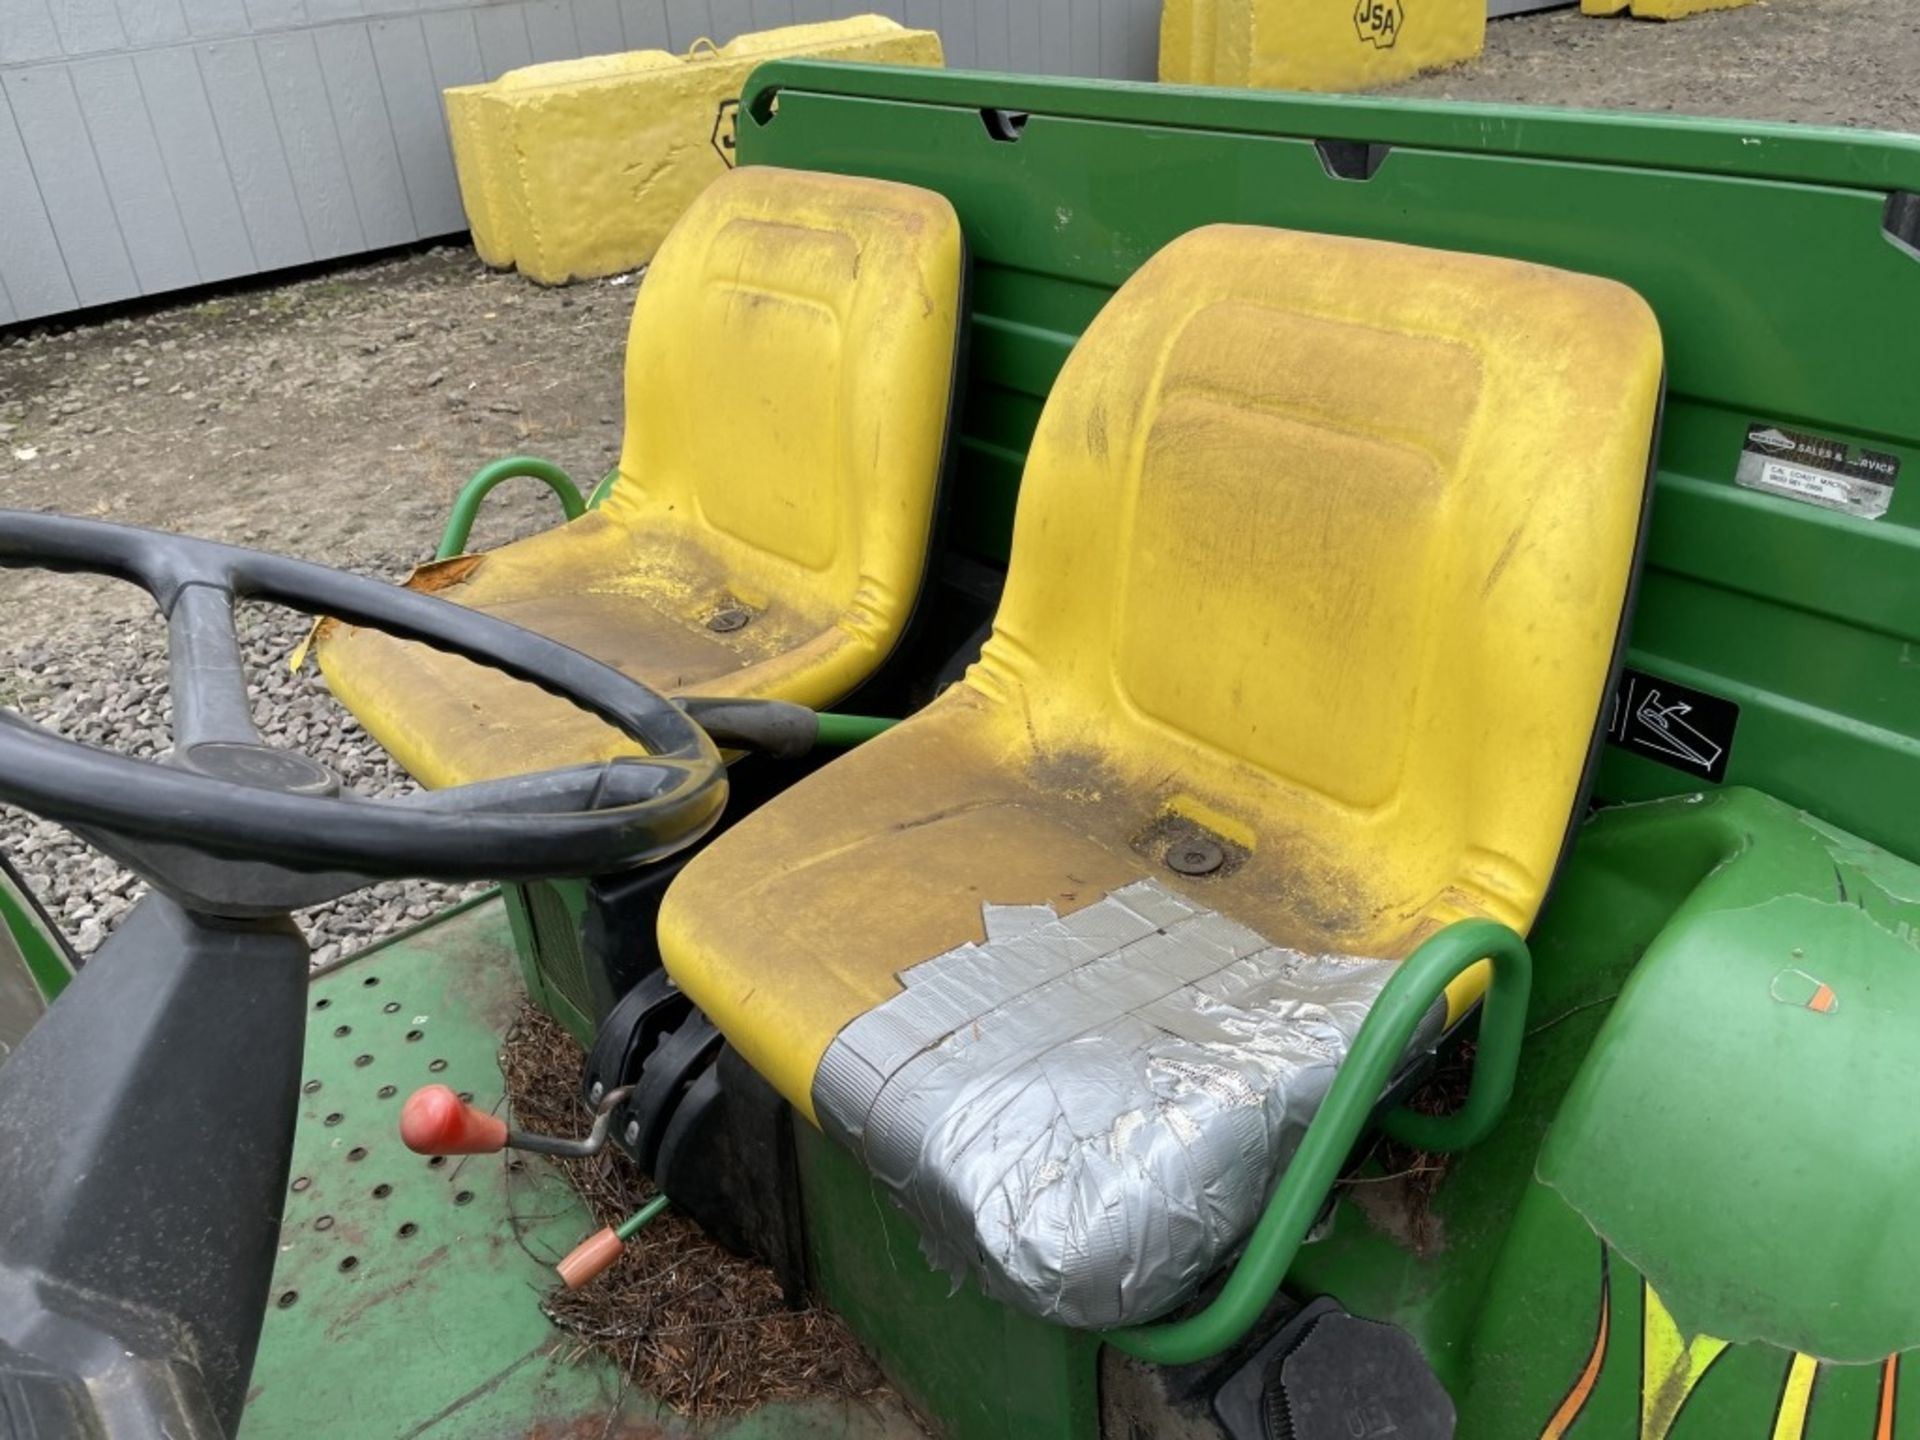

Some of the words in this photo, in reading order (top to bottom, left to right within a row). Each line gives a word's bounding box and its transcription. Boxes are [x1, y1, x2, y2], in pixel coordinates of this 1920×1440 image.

[1359, 0, 1394, 36] JSA
[1797, 443, 1833, 459] SALES
[1847, 457, 1895, 475] RVICE
